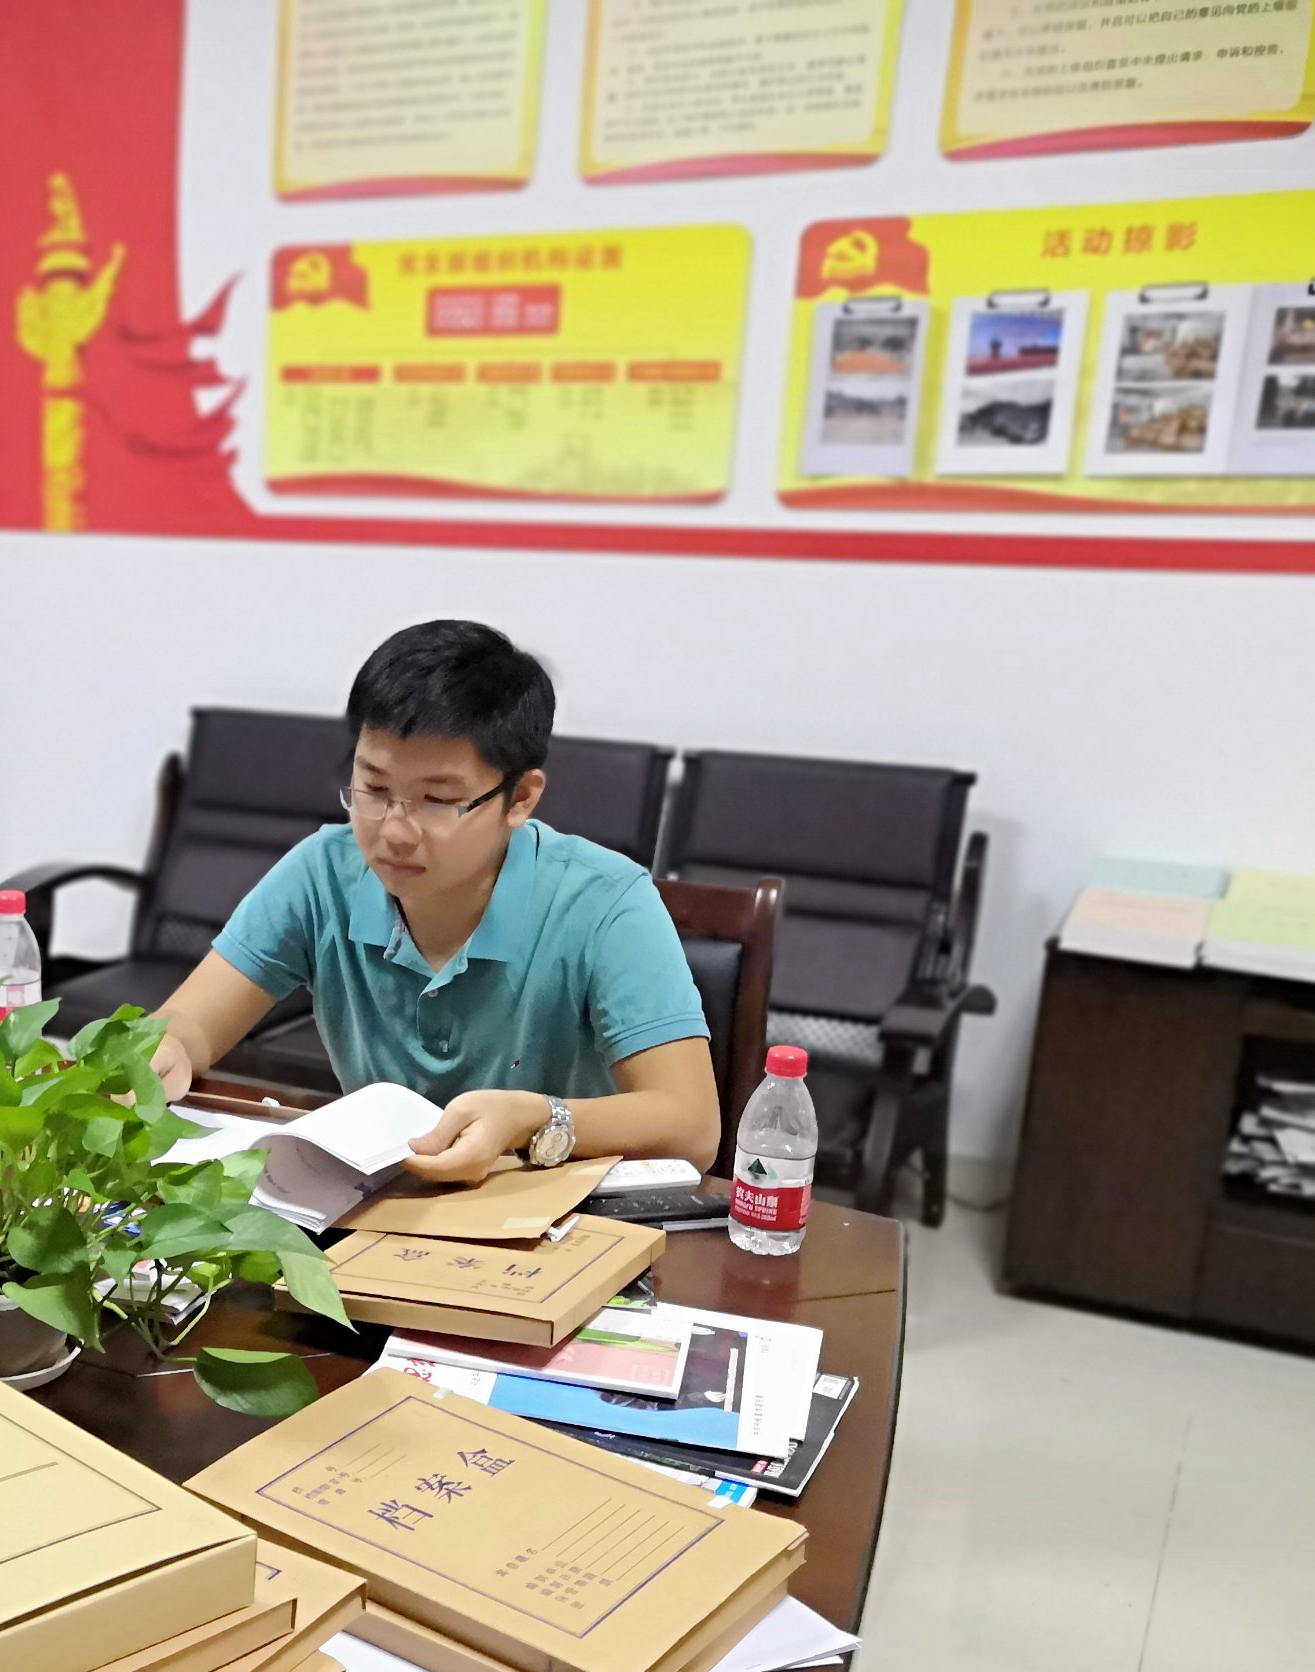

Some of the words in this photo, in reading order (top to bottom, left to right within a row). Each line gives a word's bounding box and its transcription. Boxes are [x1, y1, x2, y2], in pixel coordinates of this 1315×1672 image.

[1041, 220, 1198, 260] 活动掠影
[736, 1186, 778, 1208] 农夫山泉
[367, 1448, 516, 1531] 档案盒
